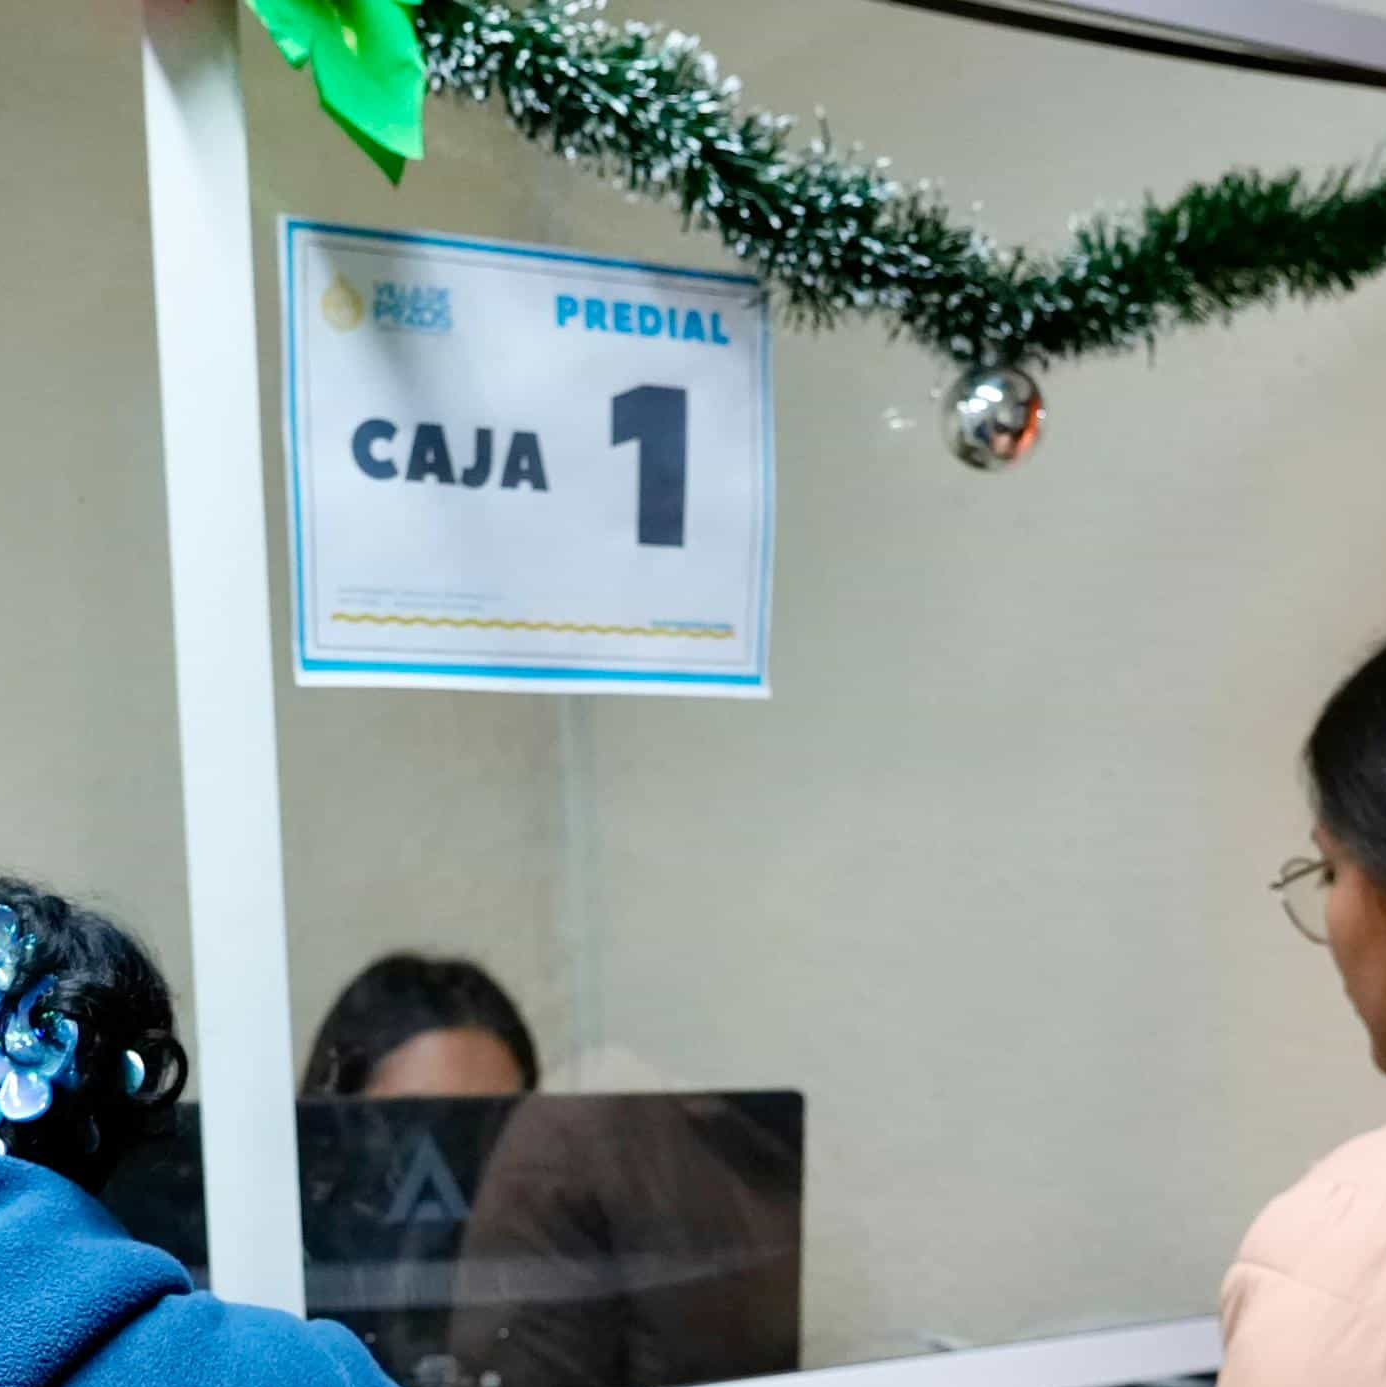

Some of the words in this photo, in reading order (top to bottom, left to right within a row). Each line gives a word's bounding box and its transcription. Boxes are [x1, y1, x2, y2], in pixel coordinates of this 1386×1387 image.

[555, 295, 730, 345] PREDIAL
[351, 418, 549, 492] CAJA
[611, 384, 687, 548] 1
